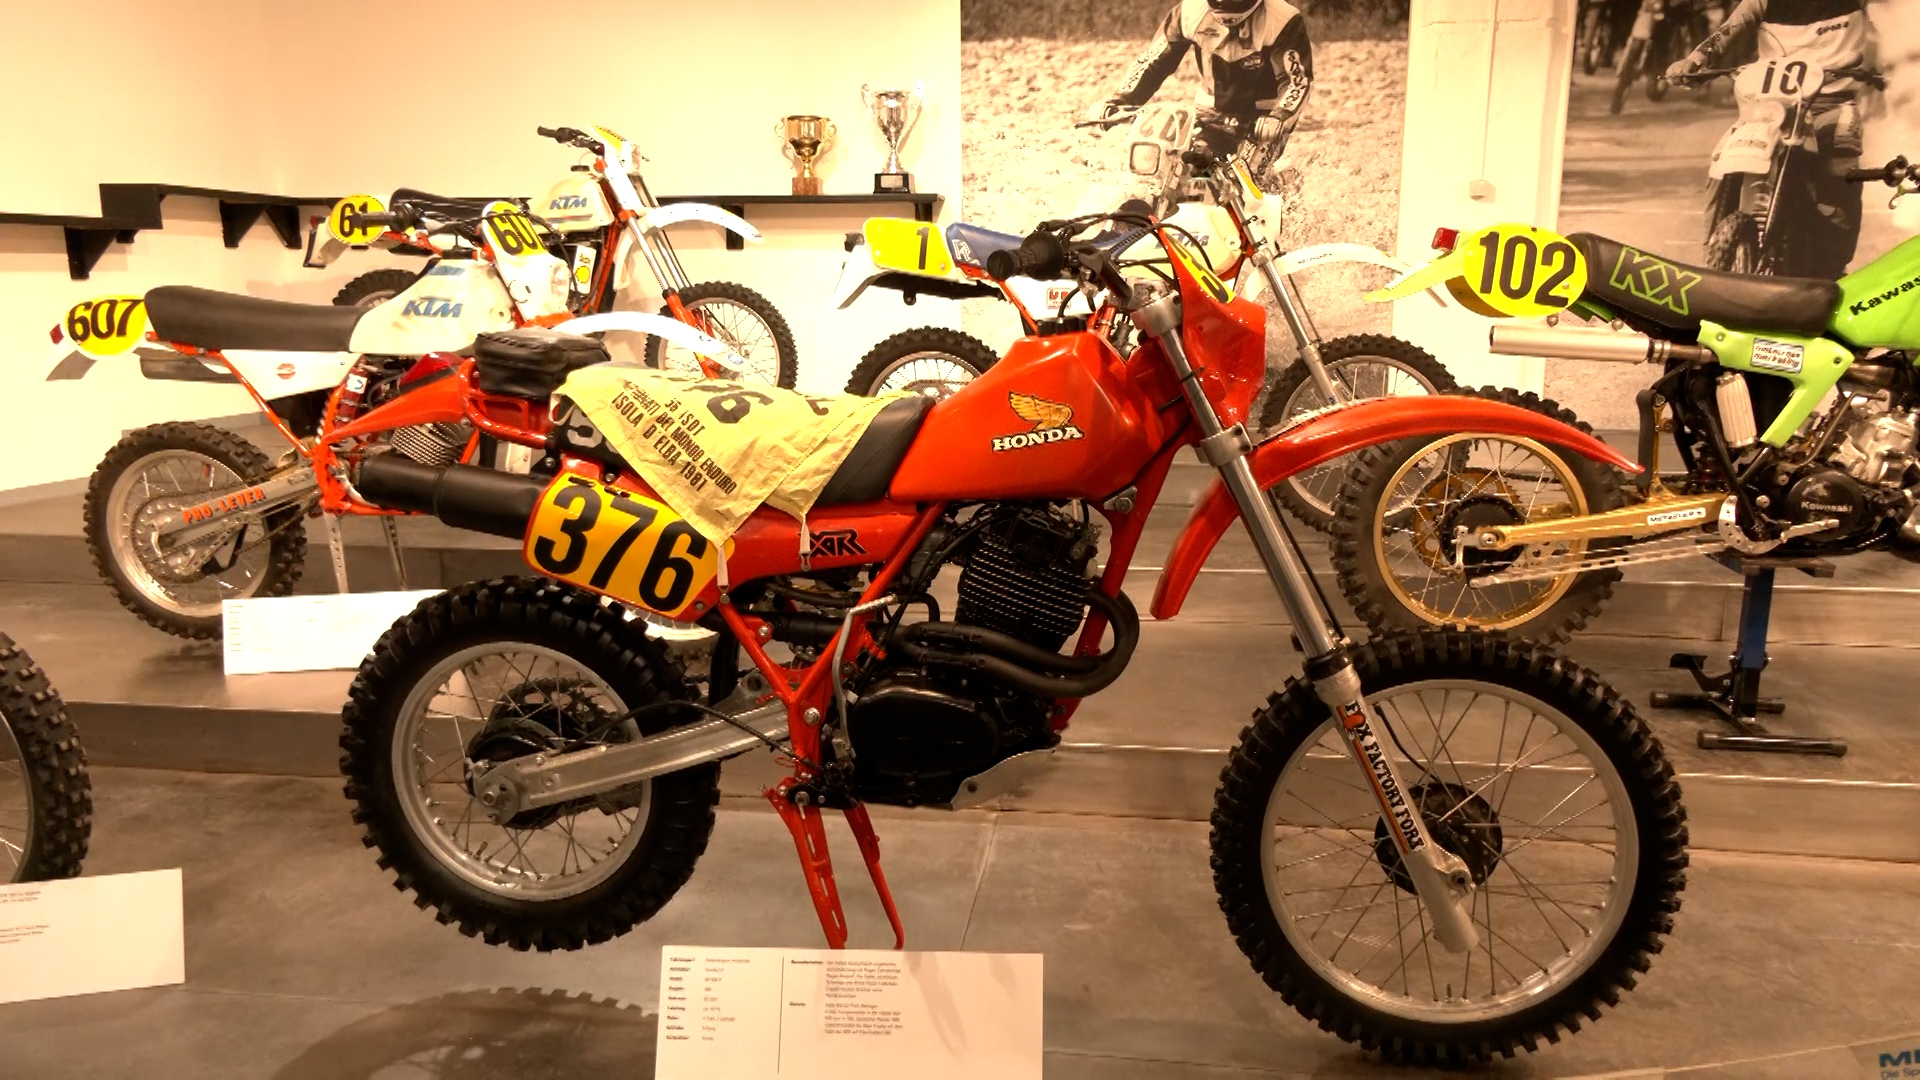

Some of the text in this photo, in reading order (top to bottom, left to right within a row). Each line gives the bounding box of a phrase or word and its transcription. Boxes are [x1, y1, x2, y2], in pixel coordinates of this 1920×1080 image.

[1761, 61, 1808, 95] 10
[549, 195, 588, 210] KTM
[916, 226, 930, 270] 1
[1479, 231, 1576, 308] 102
[401, 295, 463, 318] KTM
[1609, 245, 1702, 315] KX
[68, 299, 145, 343] 607
[611, 392, 644, 427] ISOLA
[679, 460, 708, 493] 1981
[670, 425, 704, 462] MONDO
[700, 457, 737, 495] ENDURO
[991, 424, 1085, 453] HONDA
[533, 484, 708, 612] 376
[1364, 742, 1405, 808] FACTORY
